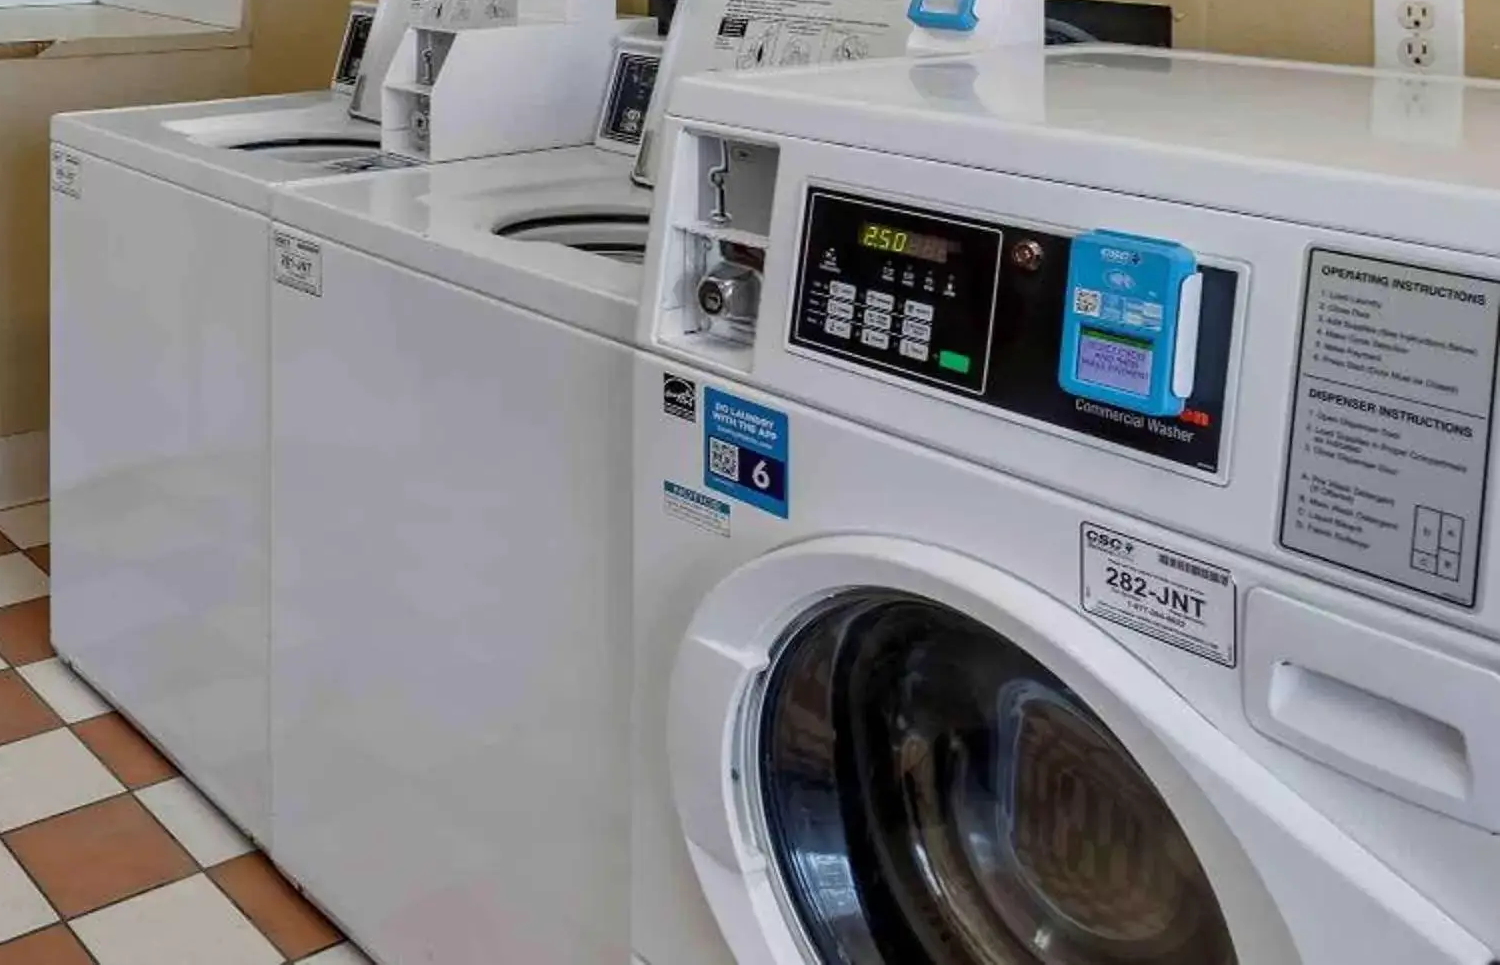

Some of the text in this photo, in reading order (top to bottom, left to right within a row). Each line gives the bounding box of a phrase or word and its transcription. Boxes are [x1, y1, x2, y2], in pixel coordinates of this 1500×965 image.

[1321, 265, 1486, 306] OPERATING INSTRUCTIONS
[1075, 399, 1195, 443] Commercial Washer
[1308, 388, 1474, 438] DISPENSER INSTRUCTIONS
[752, 459, 770, 489] 6
[1106, 566, 1207, 618] 282-JNT
